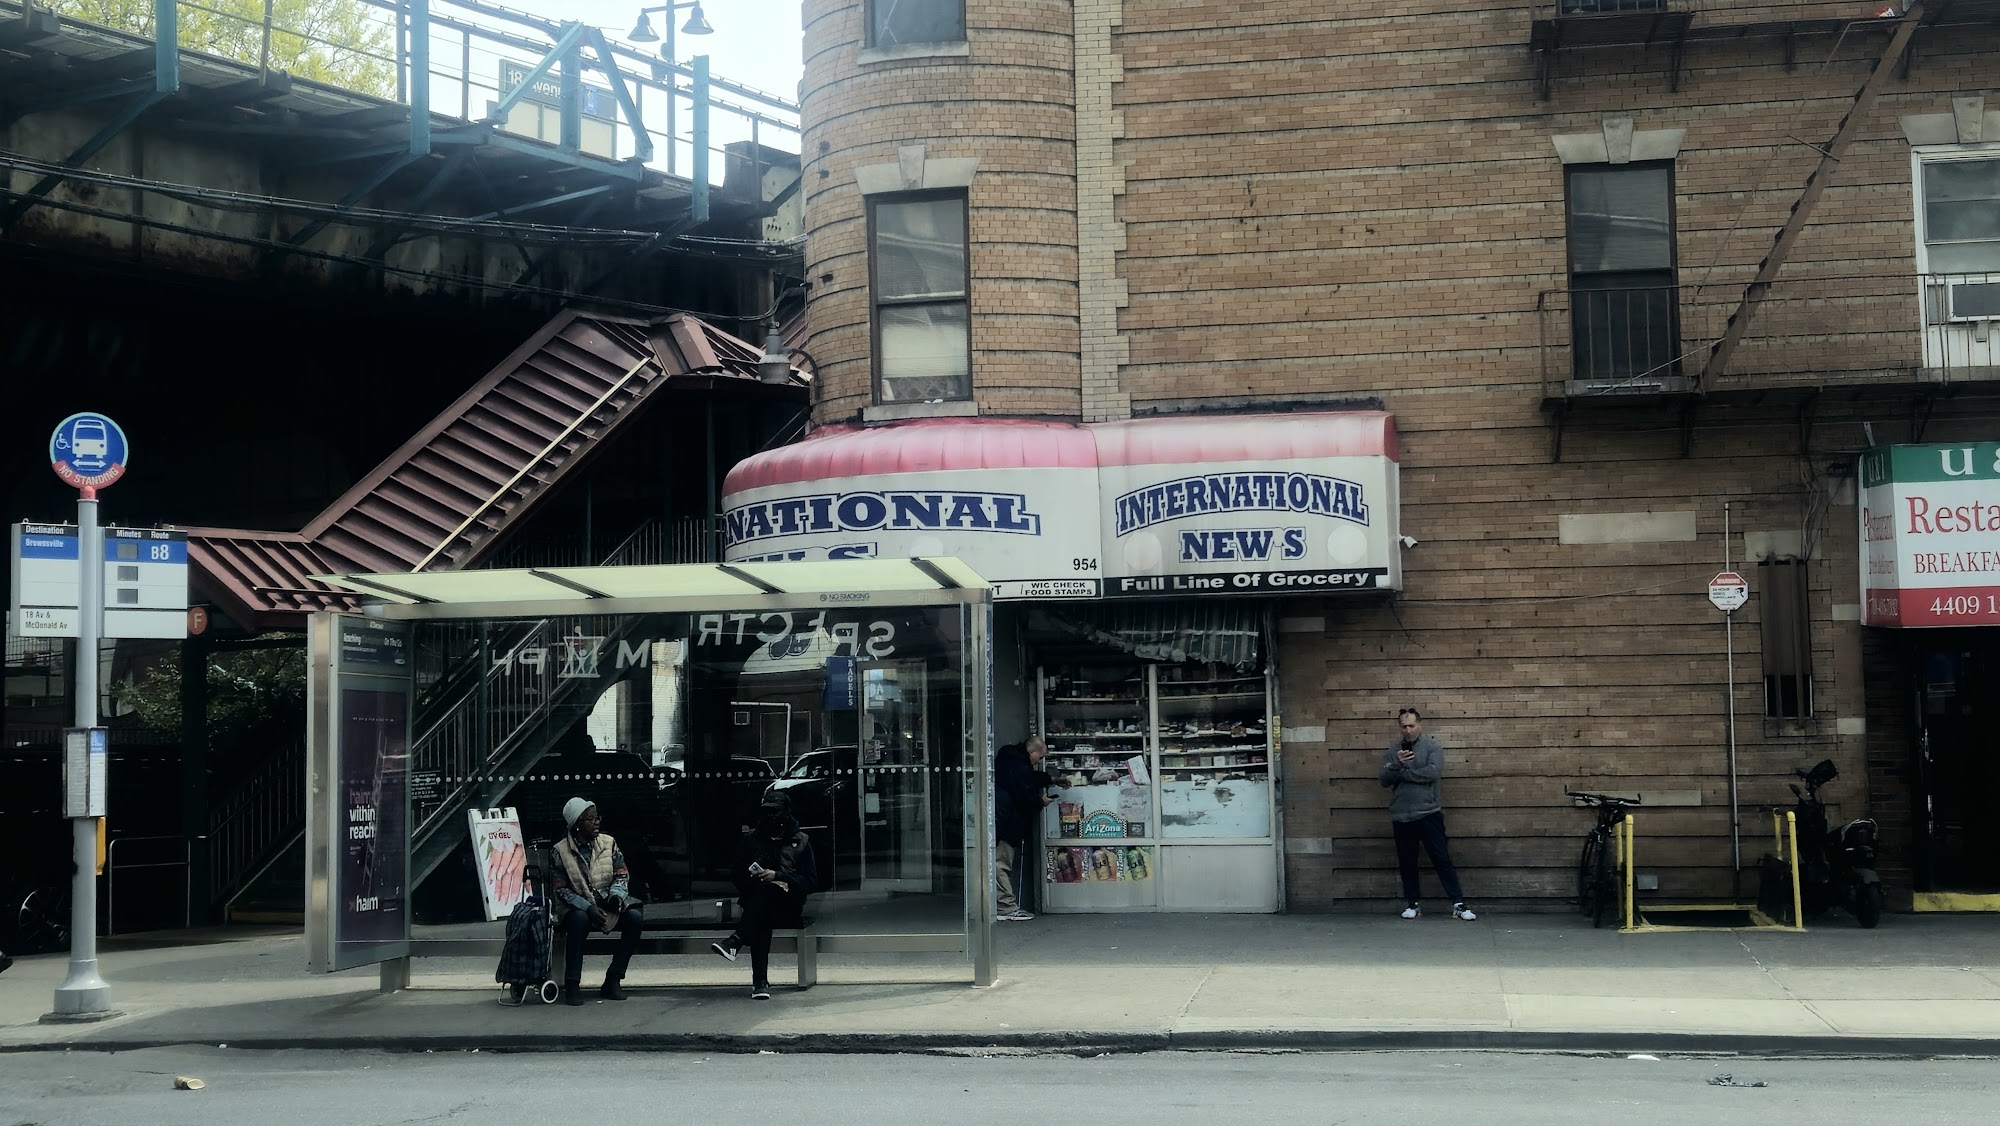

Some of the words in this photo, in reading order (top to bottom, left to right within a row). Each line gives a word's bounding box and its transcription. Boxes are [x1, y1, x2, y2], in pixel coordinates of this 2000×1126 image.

[508, 70, 523, 85] 18
[59, 465, 72, 478] NO
[74, 467, 119, 485] STANDING
[1115, 471, 1369, 537] INTERNATIONAL
[726, 491, 1041, 547] NATIONAL
[25, 525, 64, 535] Destination
[117, 530, 142, 539] Minutes
[151, 531, 170, 540] Route
[25, 538, 64, 548] Brownsville
[151, 544, 170, 560] B8
[1073, 558, 1097, 571] 954
[1121, 577, 1165, 591] Full
[1173, 576, 1225, 590] Line
[1232, 574, 1261, 587] Of
[1267, 572, 1369, 586] Grocery
[1930, 595, 1980, 616] 4409
[1986, 594, 2000, 614] 1
[25, 611, 34, 619] 18
[25, 621, 58, 629] McDonald
[349, 805, 376, 822] within
[349, 822, 375, 840] reach
